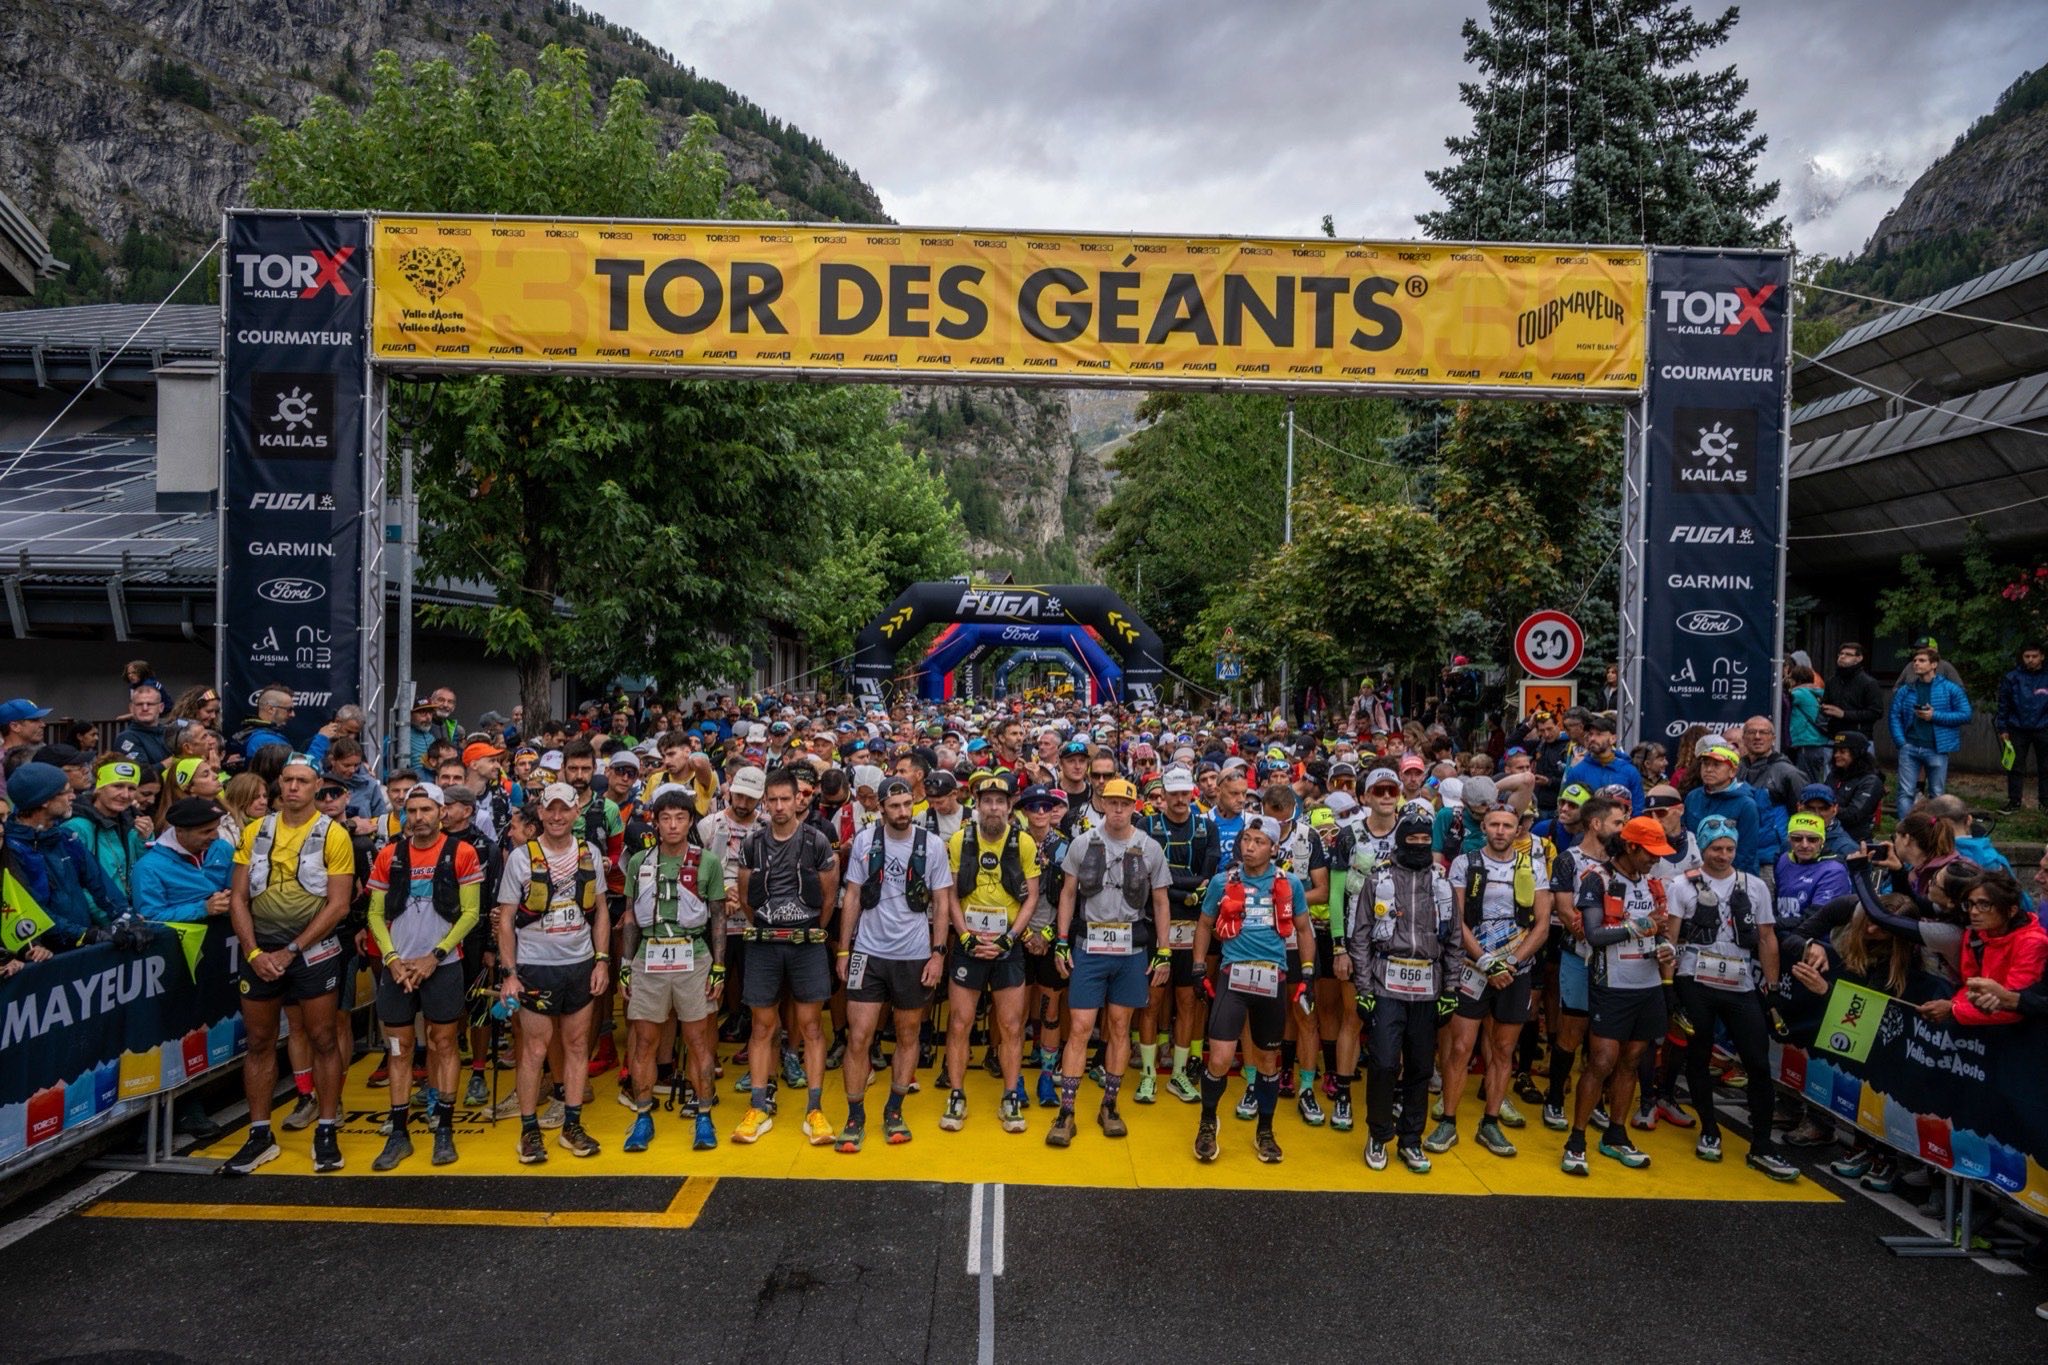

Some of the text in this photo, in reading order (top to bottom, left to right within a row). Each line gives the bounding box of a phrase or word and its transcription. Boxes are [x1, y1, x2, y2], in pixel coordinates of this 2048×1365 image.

[384, 227, 1641, 266] TOR330 TOR330 TOR330 TOR330 TOR330 TOR330 TOR330 TOR330 TOR330 TOR330 TOR330 TOR330 TOR330 TOR330 TOR330 TOR330 TOR330 TOR330 TOR330 TOR330 TOR330 TOR330 TOR330 TOR330
[236, 247, 356, 299] TORX
[254, 290, 298, 298] KAILAS
[595, 258, 789, 335] TOR
[819, 263, 989, 340] DES
[402, 310, 428, 320] Valle
[1660, 284, 1777, 336] TORX
[1518, 290, 1624, 348] COURMAYEUR
[398, 322, 430, 333] Vallée
[1678, 326, 1721, 335] KAILAS
[237, 330, 352, 345] COURMAYEUR
[382, 344, 408, 352] FUGA
[435, 345, 462, 353] FUGA
[489, 346, 516, 354] FUGA
[542, 348, 569, 356] FUGA
[596, 349, 623, 357] FUGA
[649, 350, 676, 358] FUGA
[756, 352, 783, 360] FUGA
[810, 353, 836, 361] FUGA
[864, 354, 890, 362] FUGA
[917, 355, 943, 363] FUGA
[970, 357, 996, 365] FUGA
[1024, 358, 1050, 366] FUGA
[1077, 360, 1103, 368] FUGA
[1130, 361, 1156, 369] FUGA
[1183, 363, 1209, 371] FUGA
[1236, 364, 1262, 372] FUGA
[1288, 365, 1315, 373] FUGA
[1342, 366, 1368, 375] FUGA
[1394, 368, 1421, 376] FUGA
[1446, 370, 1472, 378] FUGA
[1499, 371, 1525, 379] FUGA
[1551, 372, 1577, 380] FUGA
[1604, 374, 1630, 382] FUGA
[1661, 365, 1774, 382] COURMAYEUR
[259, 434, 328, 447] KAILAS
[1681, 469, 1748, 482] KAILAS
[250, 492, 315, 510] FUGA
[1669, 526, 1735, 544] FUGA
[270, 580, 312, 600] Ford
[956, 596, 1038, 616] FUGA
[1688, 612, 1730, 632] Ford
[1002, 625, 1040, 642] Ford
[1531, 629, 1568, 661] 30
[1669, 685, 1705, 694] ALPISSIMA
[292, 691, 332, 707] ERVIT
[982, 857, 996, 865] BOA
[563, 909, 576, 922] 18
[981, 916, 989, 927] 4
[1103, 930, 1116, 942] 20
[1176, 928, 1183, 939] 2
[662, 948, 676, 960] 41
[850, 955, 862, 976] 590
[1719, 961, 1726, 973] 9
[1249, 968, 1261, 981] 11
[1400, 968, 1421, 982] 656
[1, 955, 166, 1049] MAYEUR
[1841, 993, 1864, 1027] TORX
